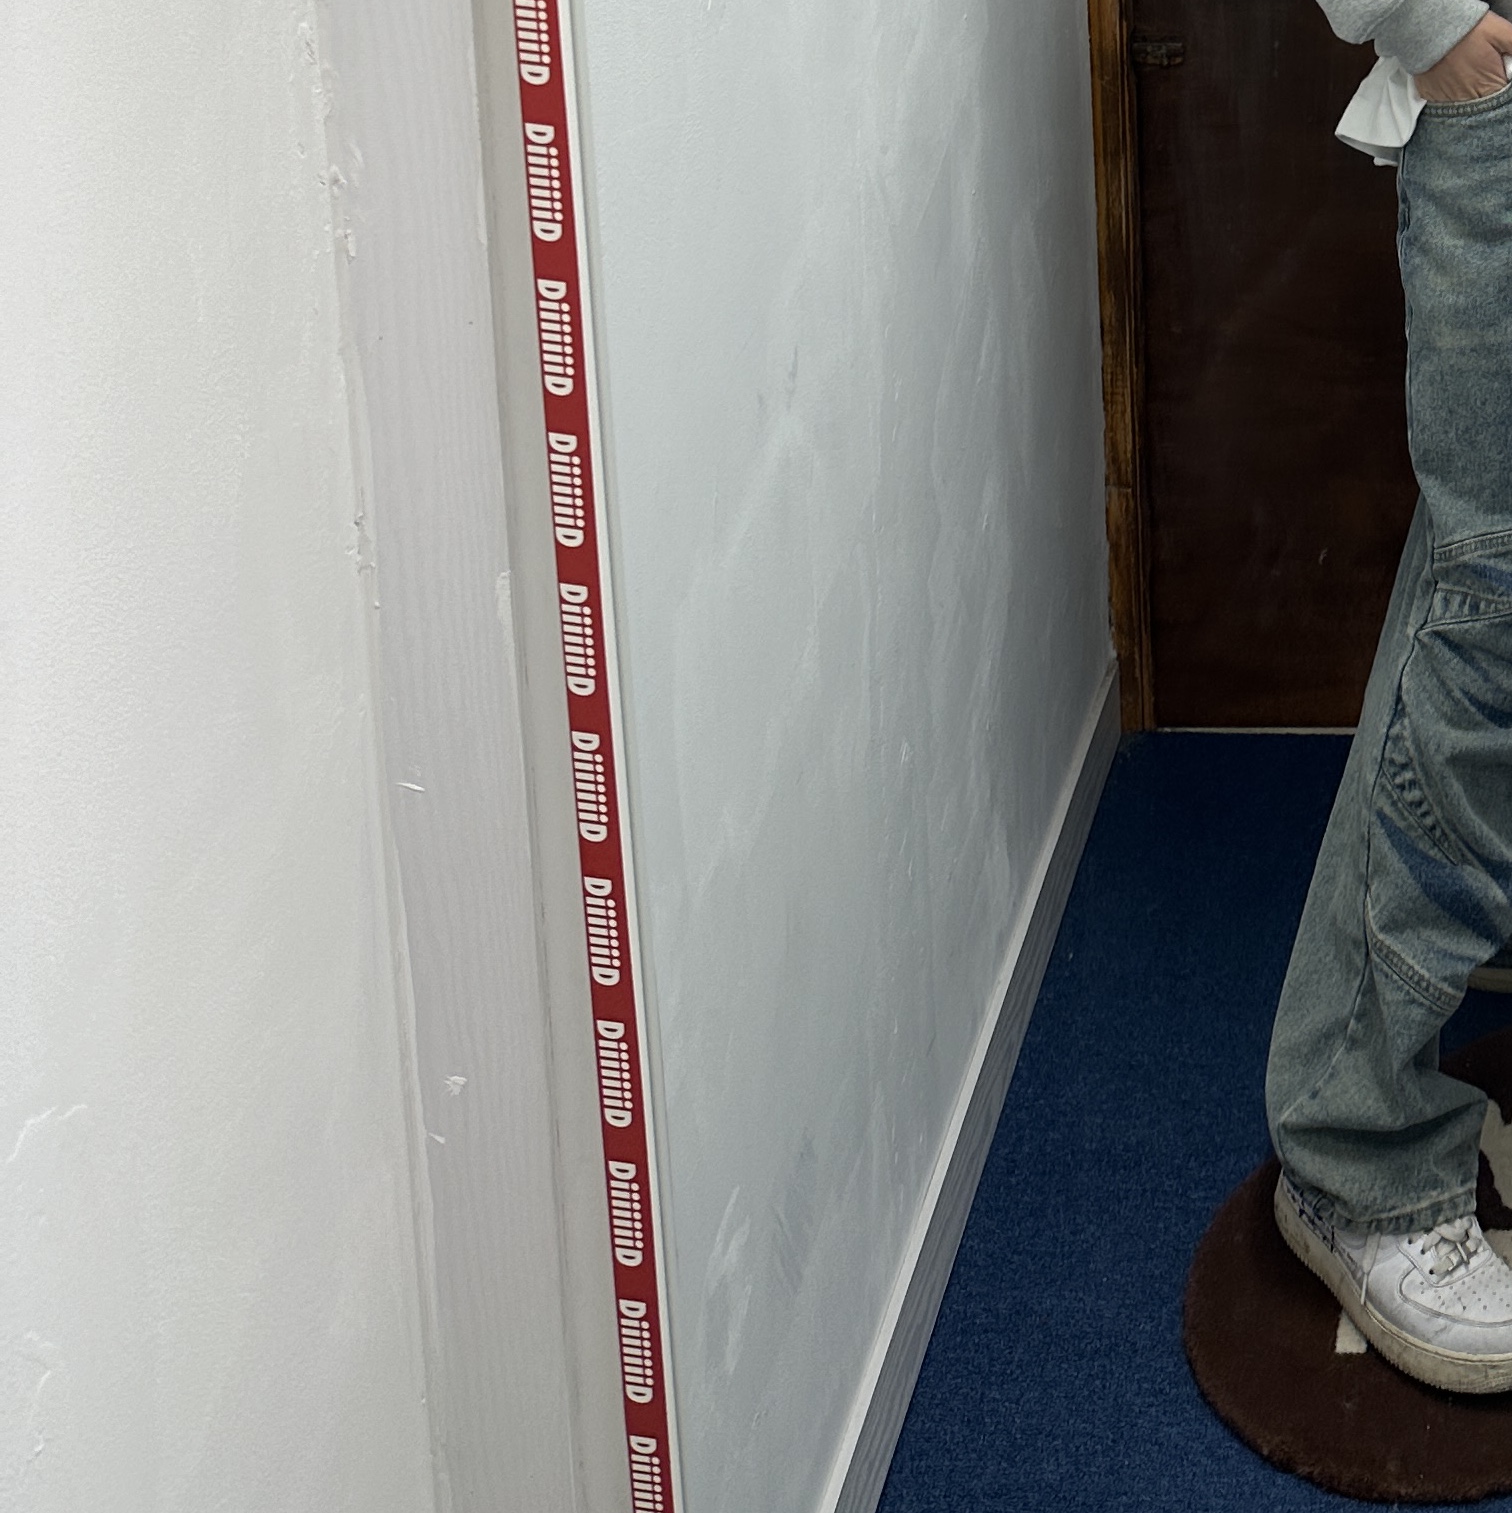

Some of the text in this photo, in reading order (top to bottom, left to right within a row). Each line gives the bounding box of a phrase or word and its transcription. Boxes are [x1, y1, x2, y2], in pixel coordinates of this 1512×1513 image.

[527, 123, 564, 241] DiiiiiiiD
[539, 279, 575, 396] DiiiiiiiD
[551, 432, 586, 547] DiiiiiiiD
[563, 583, 597, 696] DiiiiiiiD
[575, 731, 609, 842] DiiiiiiiD
[586, 877, 622, 986] DiiiiiiiD
[599, 1020, 634, 1127] DiiiiiiiD
[609, 1161, 645, 1266] DiiiiiiiD
[618, 1299, 655, 1403] DiiiiiiiD
